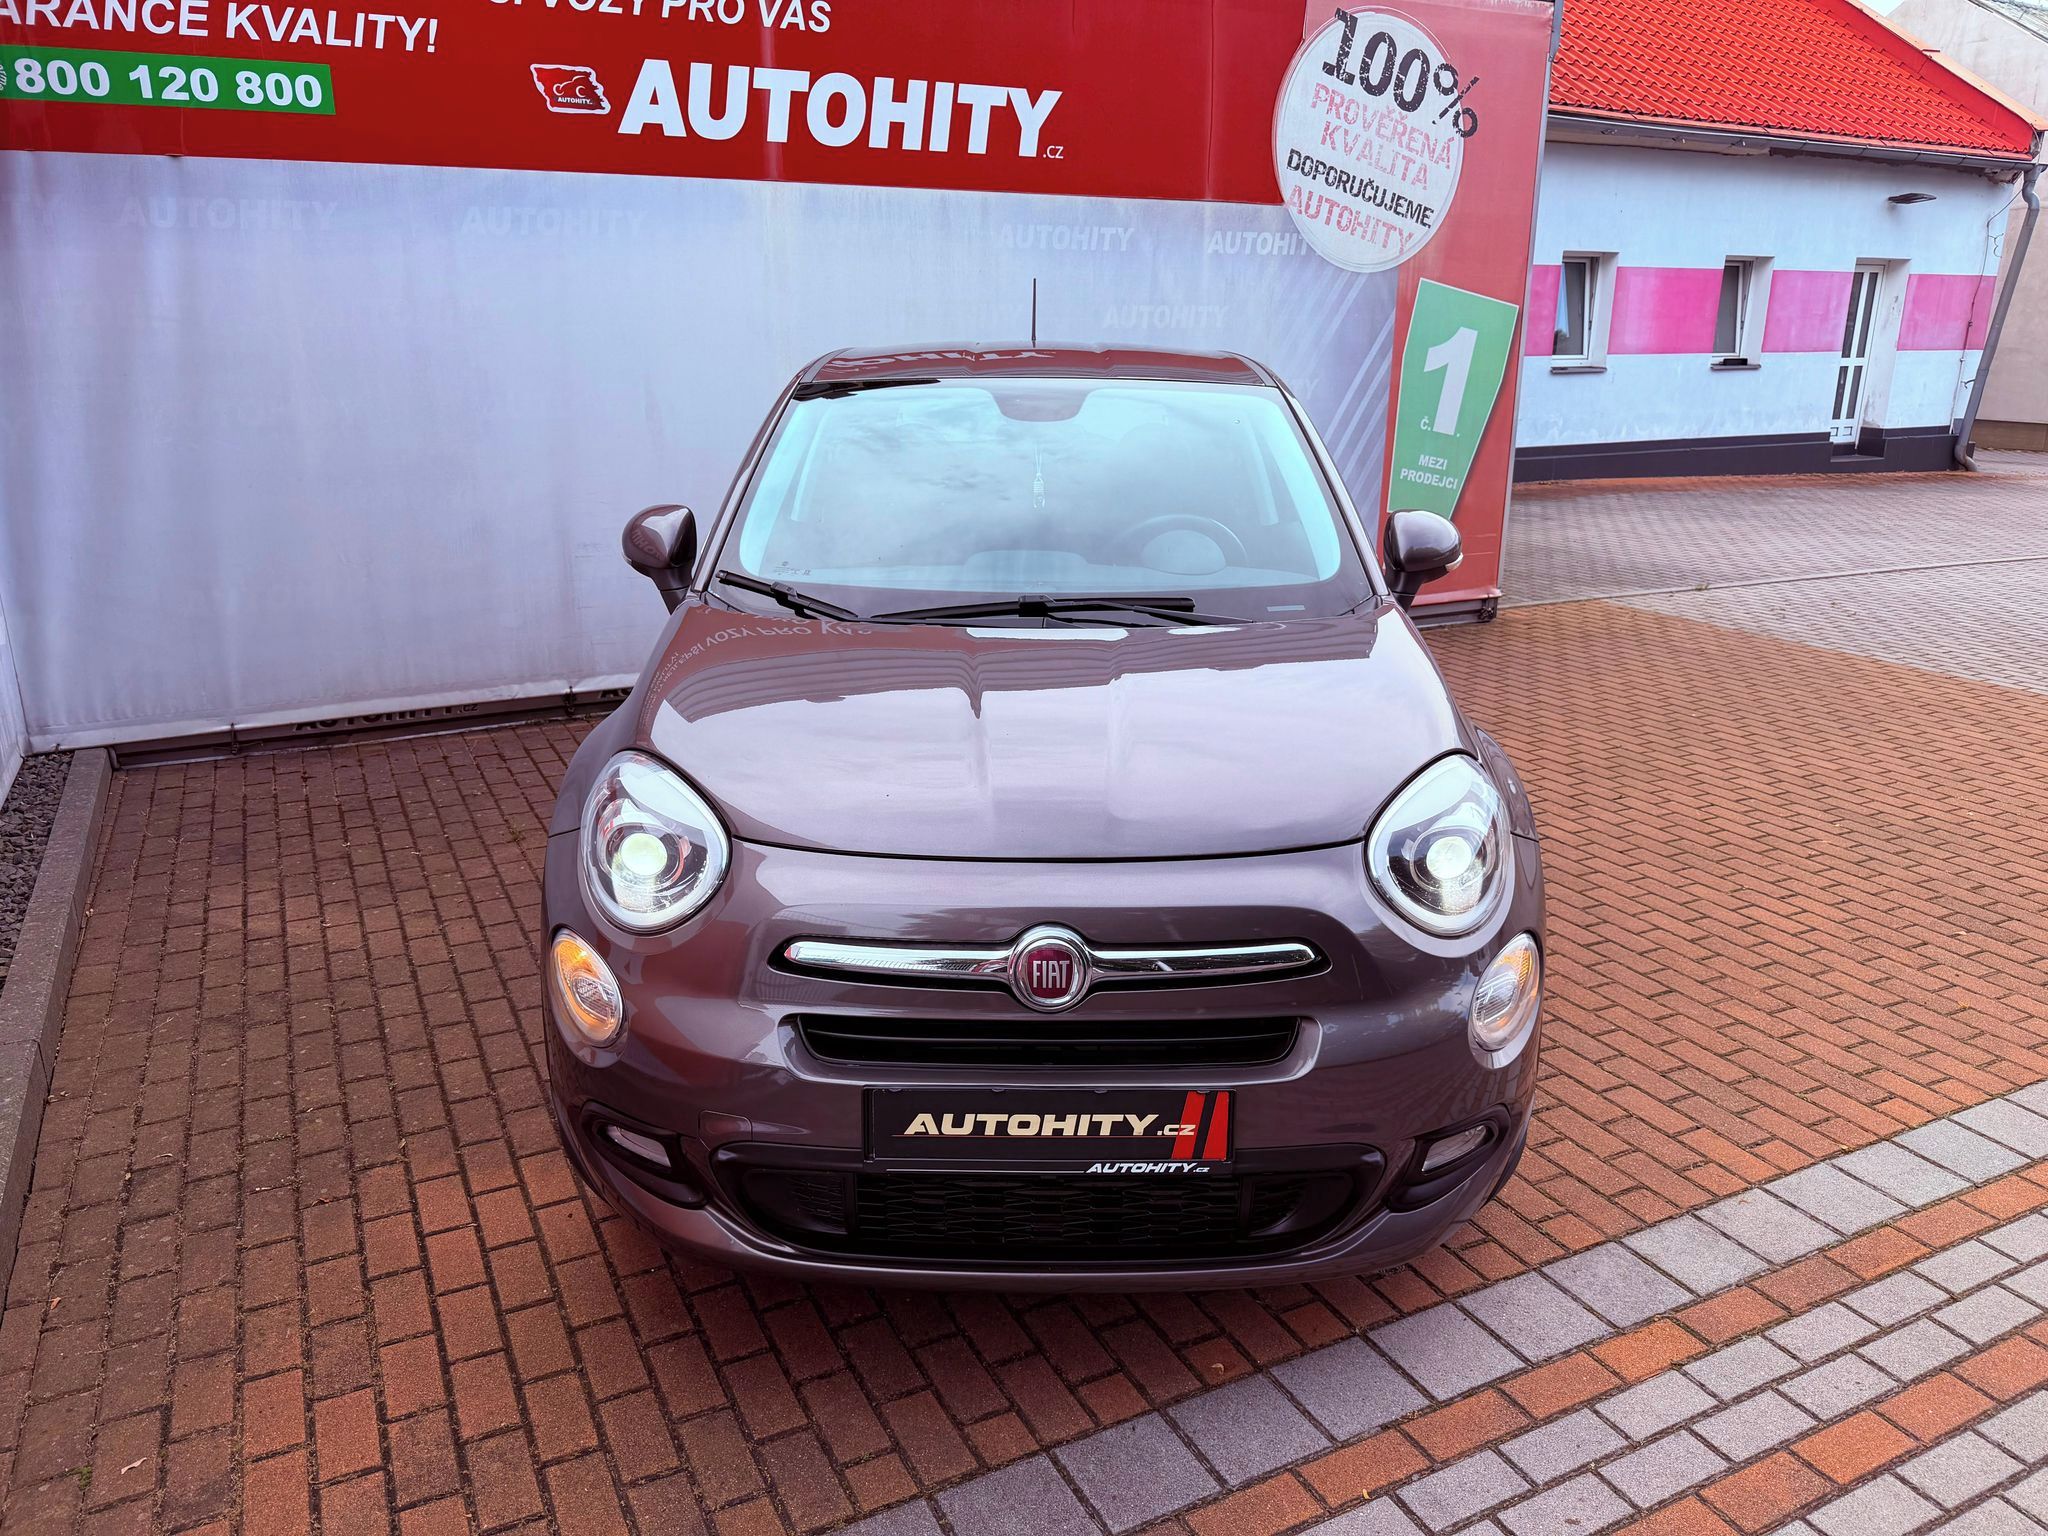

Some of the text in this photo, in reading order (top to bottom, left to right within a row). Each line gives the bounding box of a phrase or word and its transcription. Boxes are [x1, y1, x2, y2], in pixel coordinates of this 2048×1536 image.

[226, 1, 438, 53] KVALITY!
[14, 57, 110, 97] 800
[129, 64, 219, 102] 120
[236, 70, 323, 107] 800
[1321, 8, 1480, 138] 100%
[1310, 82, 1455, 170] PROVĚŘENÁ
[1320, 120, 1428, 191] KVALITA
[1286, 148, 1434, 229] DOPORUČUJEME
[1000, 224, 1135, 251] AUTOHITY
[1207, 230, 1318, 256] AUTOHIT
[1287, 184, 1415, 253] AUTOHITY
[1103, 305, 1229, 329] AUTOHITY
[1400, 468, 1459, 490] PRODEJCI
[1418, 454, 1448, 470] MEZI
[1032, 960, 1070, 989] FIAT
